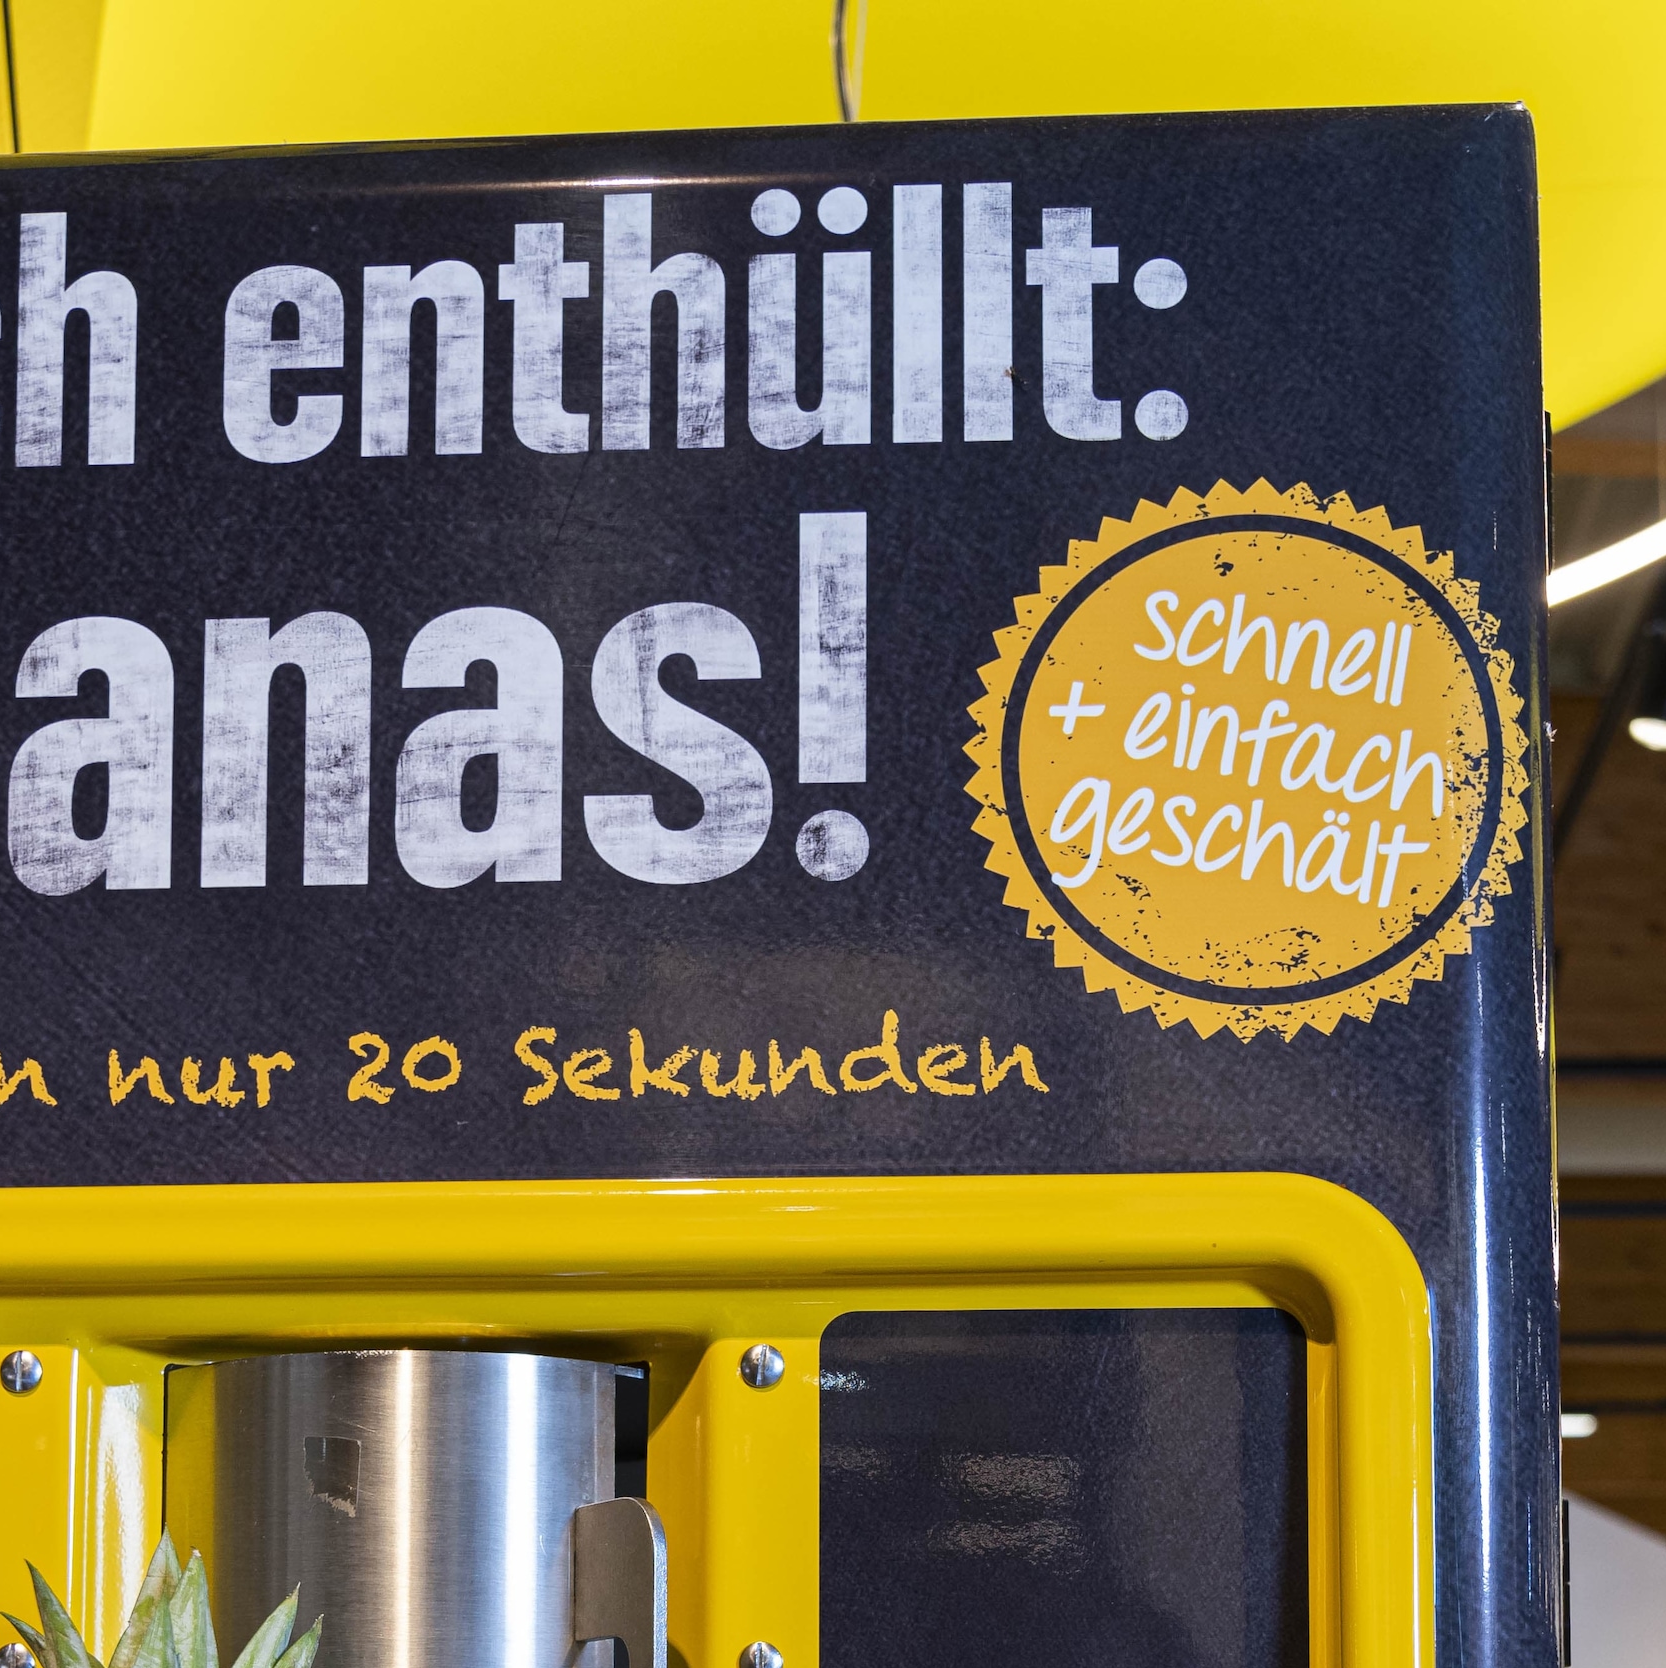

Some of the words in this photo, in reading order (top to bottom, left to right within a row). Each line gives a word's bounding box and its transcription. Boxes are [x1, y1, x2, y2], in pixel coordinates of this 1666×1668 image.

[221, 180, 1191, 466] enthüllt:
[1132, 588, 1414, 708] schnell
[1123, 683, 1445, 819] einfach
[1048, 777, 1431, 909] geschält
[108, 1048, 296, 1109] nur
[347, 1032, 463, 1106] 20
[514, 1009, 1050, 1107] Sekunden
